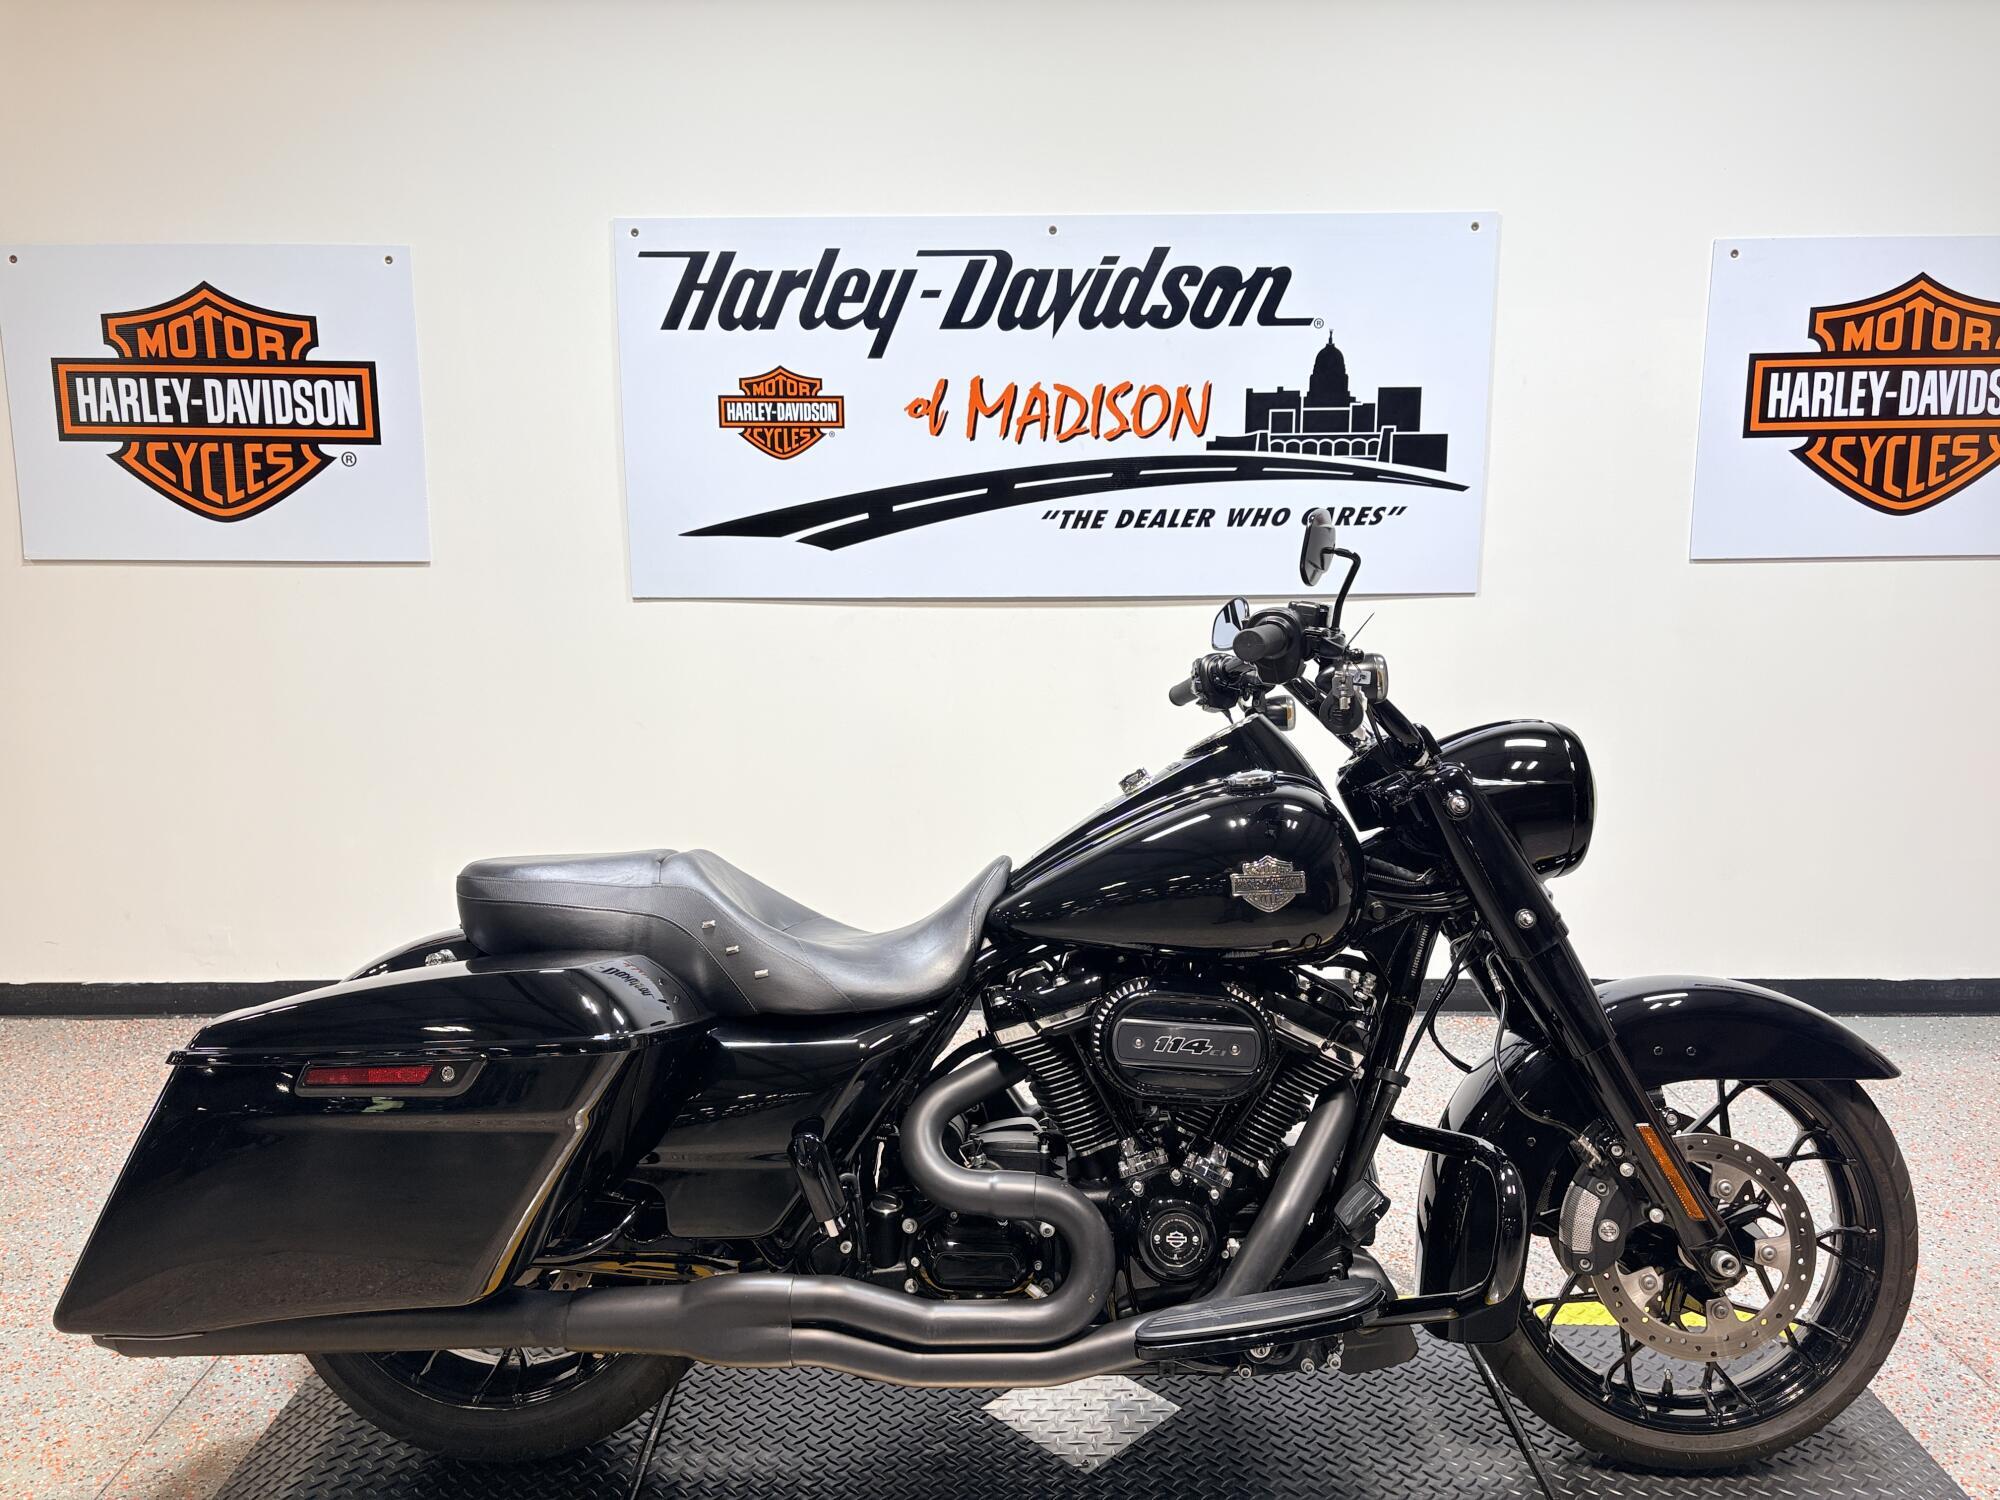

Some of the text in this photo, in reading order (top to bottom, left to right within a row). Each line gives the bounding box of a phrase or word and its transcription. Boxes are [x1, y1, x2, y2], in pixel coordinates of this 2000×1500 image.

[638, 247, 1314, 359] Harley-Davidson
[1842, 296, 1992, 351] MOTOR
[136, 304, 286, 361] MOTOR
[75, 377, 359, 426] HARLEY-DAVIDSON
[752, 374, 811, 396] MOTOR
[904, 375, 1213, 445] of MADISON
[726, 402, 837, 422] HARLEY-DAVIDSON
[752, 427, 812, 453] CYCLES
[1831, 434, 1980, 498] CYCLES
[145, 441, 294, 505] CYCLES
[1115, 508, 1216, 529] DEALER
[1226, 507, 1291, 528] WHO
[1153, 1035, 1214, 1055] 114
